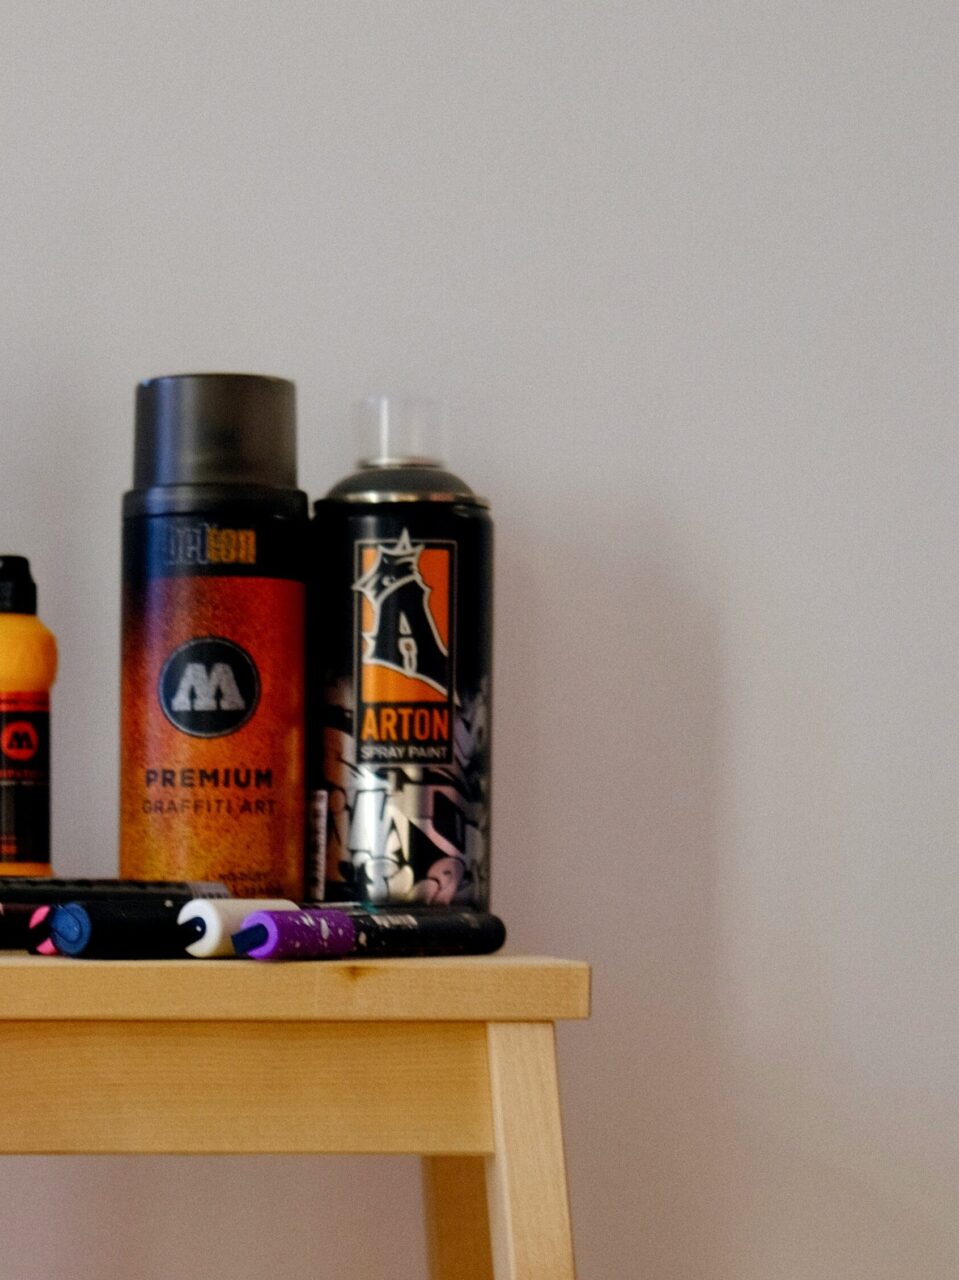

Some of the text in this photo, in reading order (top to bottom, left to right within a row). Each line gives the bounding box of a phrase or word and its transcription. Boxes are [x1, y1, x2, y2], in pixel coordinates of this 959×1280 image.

[361, 707, 448, 741] ARTON
[361, 746, 447, 758] SPRAY PAINT
[145, 768, 273, 788] PREMIUM
[143, 798, 275, 815] GRAFFITI ART
